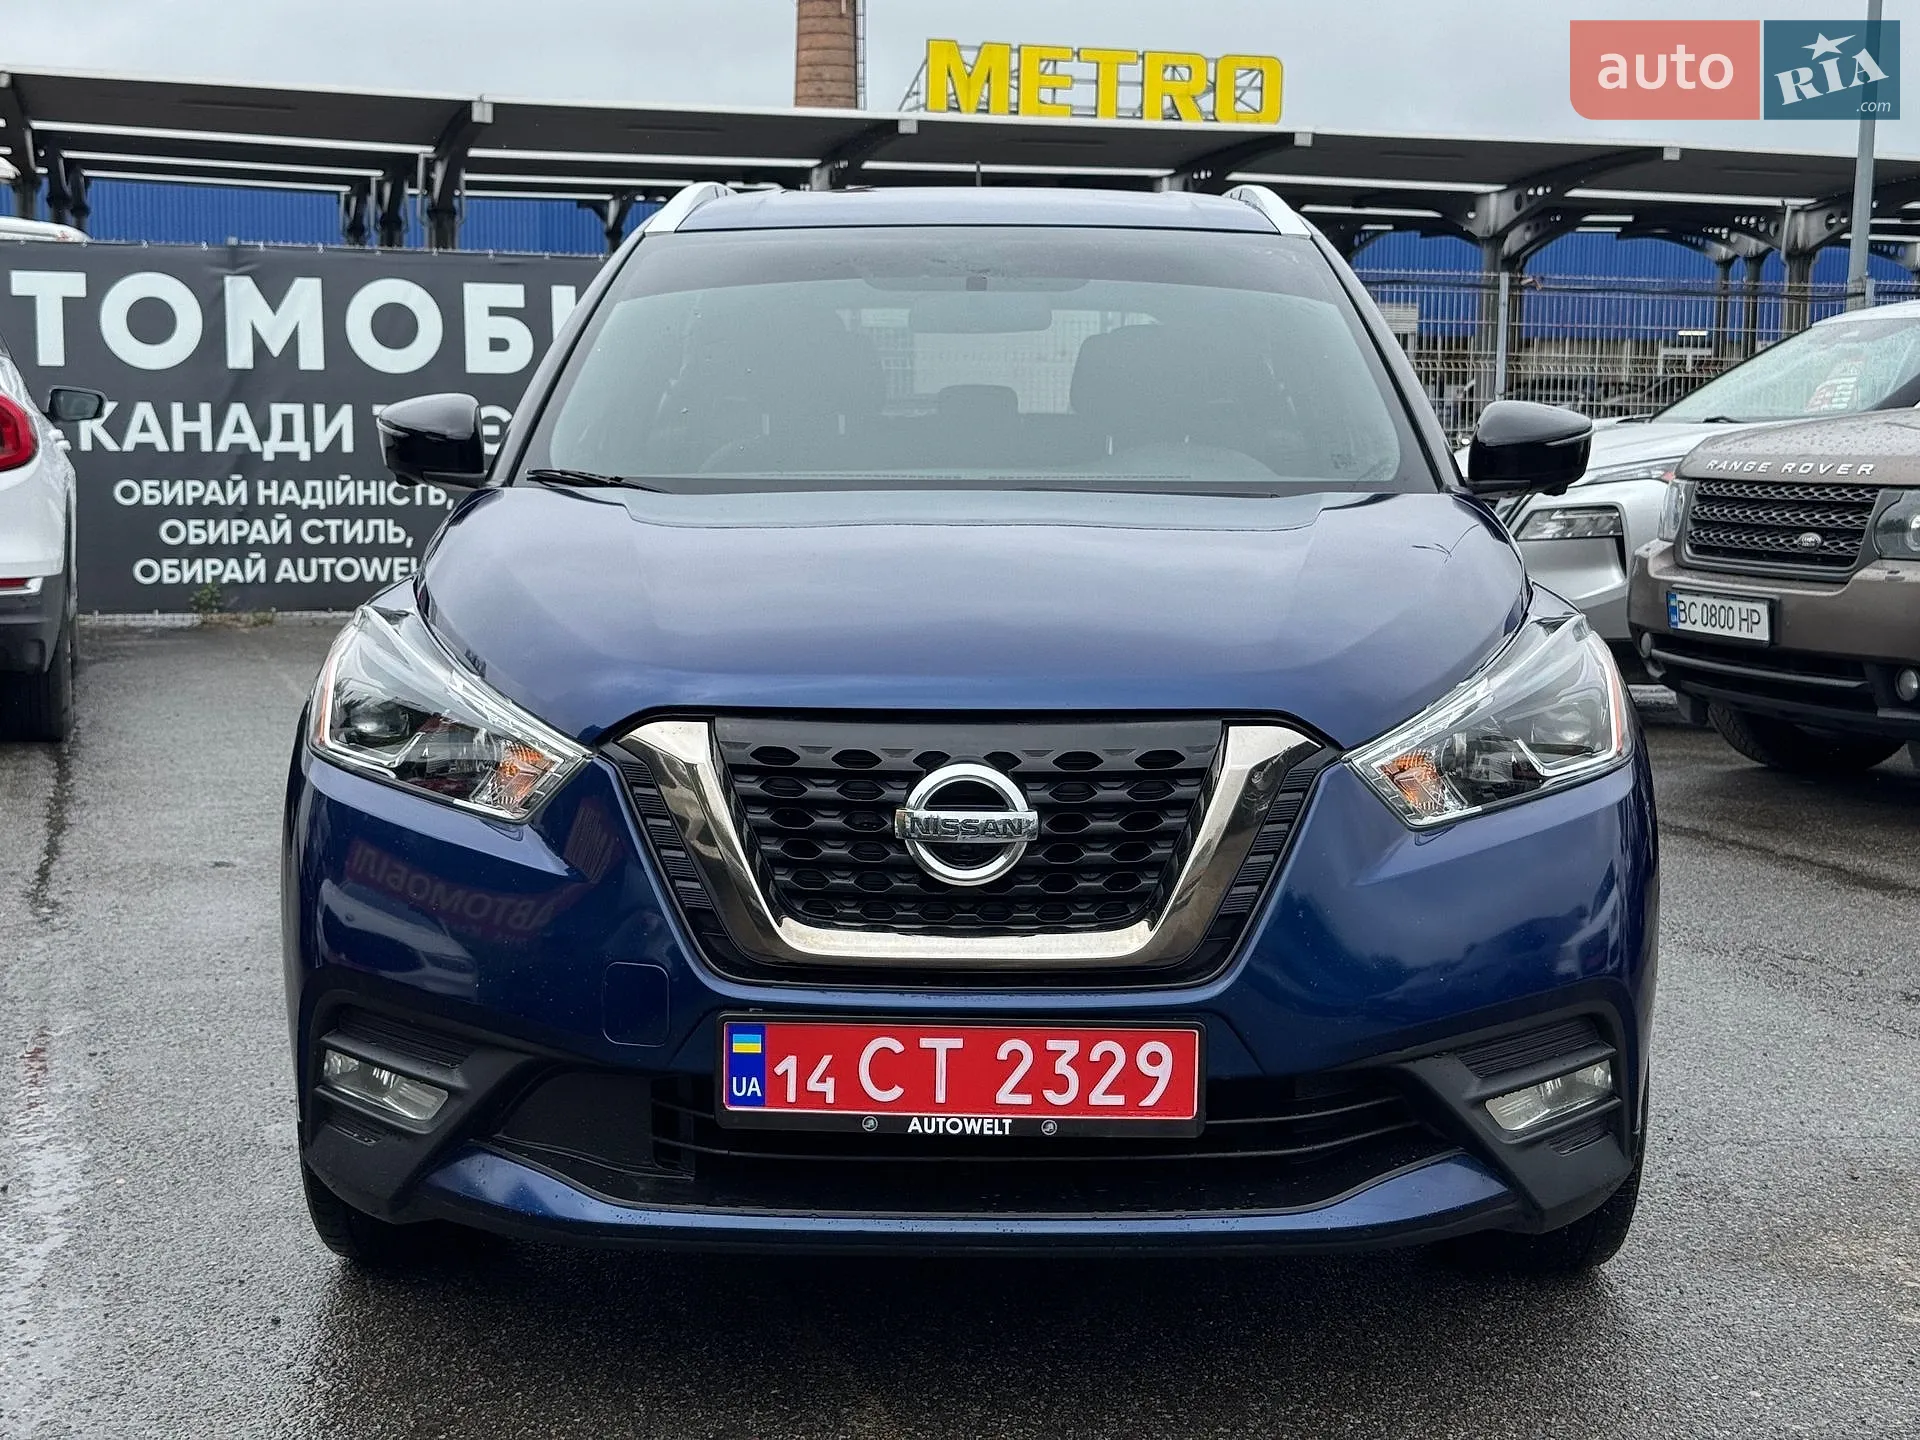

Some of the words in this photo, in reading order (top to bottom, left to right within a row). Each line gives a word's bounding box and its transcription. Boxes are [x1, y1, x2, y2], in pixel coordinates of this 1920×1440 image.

[926, 39, 1283, 125] METRO
[79, 401, 355, 461] КАНАДИ
[1706, 459, 1772, 473] RANGE
[1781, 462, 1875, 476] ROVER
[113, 474, 248, 506] ОБИРАЙ
[257, 474, 455, 511] НАДІЙНІСТЬ,
[159, 513, 291, 545] ОБИРАЙ
[300, 519, 414, 549] СТИЛЬ,
[133, 552, 266, 585] ОБИРАЙ
[1678, 600, 1698, 625] BC
[1701, 603, 1735, 630] 0800
[1738, 607, 1761, 634] HP
[910, 817, 1023, 836] NISSAN
[732, 1077, 762, 1097] UA
[773, 1053, 835, 1104] 14
[858, 1037, 964, 1104] CT
[995, 1039, 1174, 1107] 2329
[907, 1116, 1013, 1136] AUTOWELT
